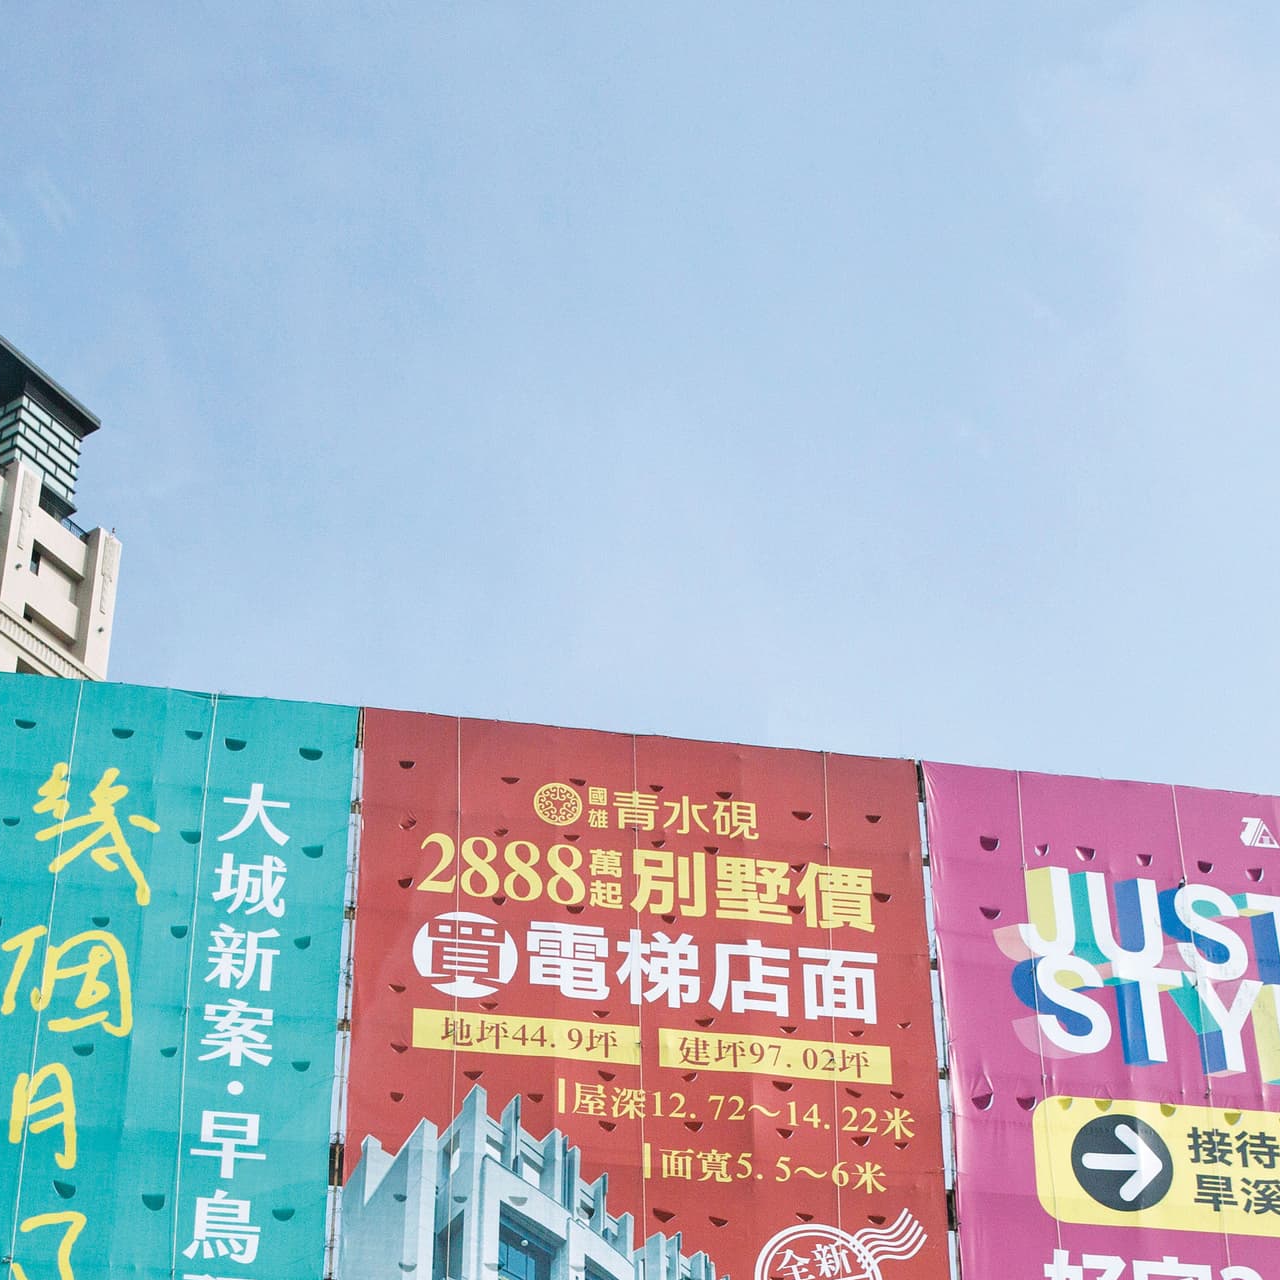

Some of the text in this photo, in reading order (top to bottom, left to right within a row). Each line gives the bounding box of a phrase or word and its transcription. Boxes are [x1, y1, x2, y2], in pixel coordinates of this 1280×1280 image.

[588, 786, 759, 840] 國雄 青水硯
[416, 832, 876, 934] 2888 萬起 別墅價
